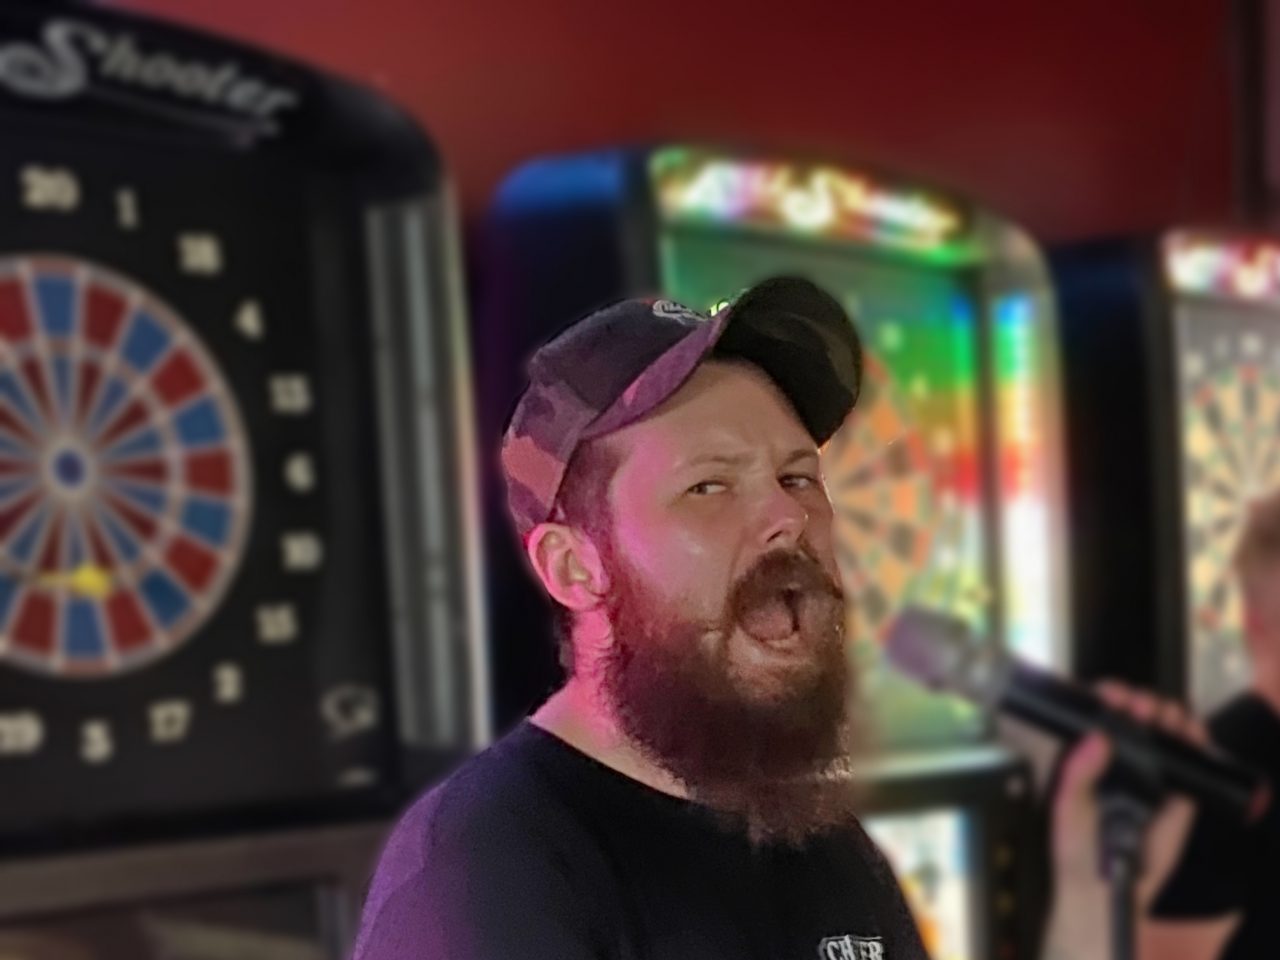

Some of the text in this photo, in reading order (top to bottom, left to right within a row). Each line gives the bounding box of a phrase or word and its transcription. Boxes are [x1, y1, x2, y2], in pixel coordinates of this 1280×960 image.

[0, 19, 298, 115] Shooter
[22, 167, 79, 209] 20
[117, 189, 137, 227] 1
[236, 302, 262, 338] 4
[150, 702, 190, 740] 17
